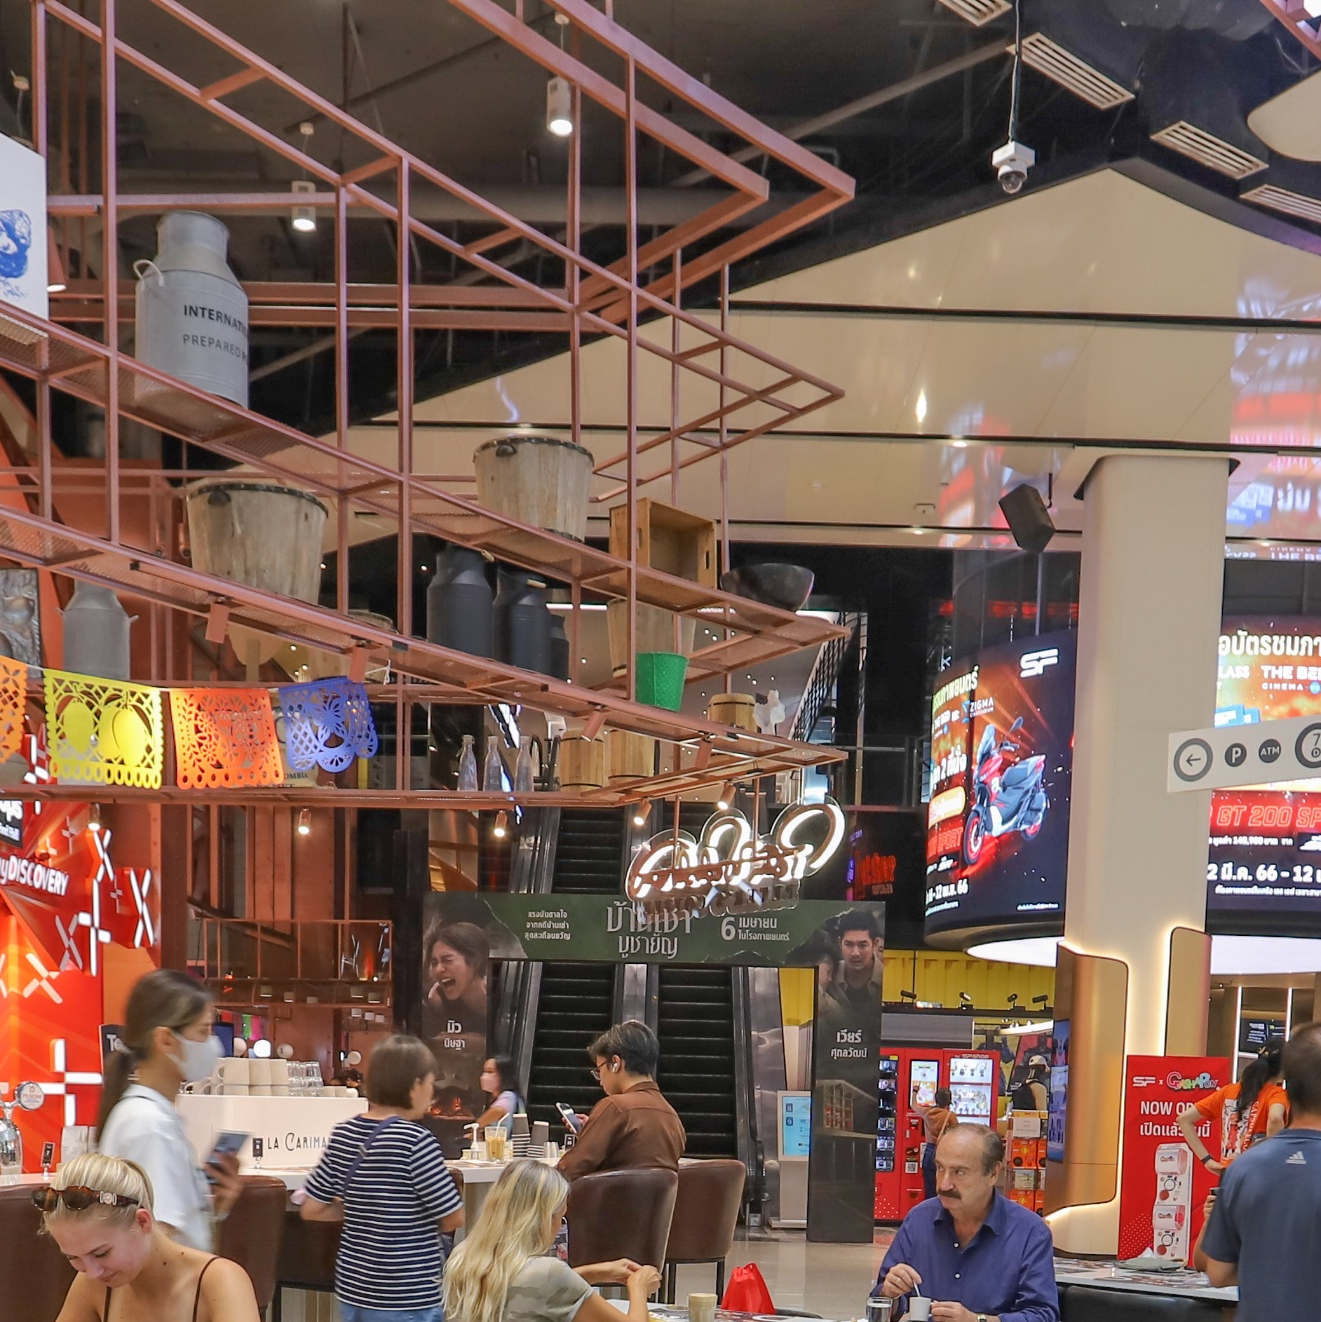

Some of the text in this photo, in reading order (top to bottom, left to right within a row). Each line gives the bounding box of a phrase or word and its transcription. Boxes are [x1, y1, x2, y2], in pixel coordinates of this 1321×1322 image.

[1020, 648, 1058, 678] SF
[1261, 665, 1295, 679] THE
[1261, 683, 1304, 691] CINEMA
[1312, 733, 1321, 746] 7
[1231, 747, 1241, 763] P
[1260, 745, 1279, 757] ATM
[1217, 805, 1246, 827] GT
[1248, 805, 1293, 828] 200
[1256, 864, 1278, 881] 66
[1293, 865, 1313, 883] 12
[721, 916, 777, 941] 6 เมษายน
[618, 933, 678, 959] บูชายัญ
[447, 1020, 462, 1034] มิว
[836, 1029, 862, 1043] เวียร์
[444, 1038, 466, 1050] นิษฐา
[1132, 1076, 1156, 1087] SF
[1140, 1101, 1196, 1115] NOW OP
[267, 1132, 328, 1151] LA CARIMA
